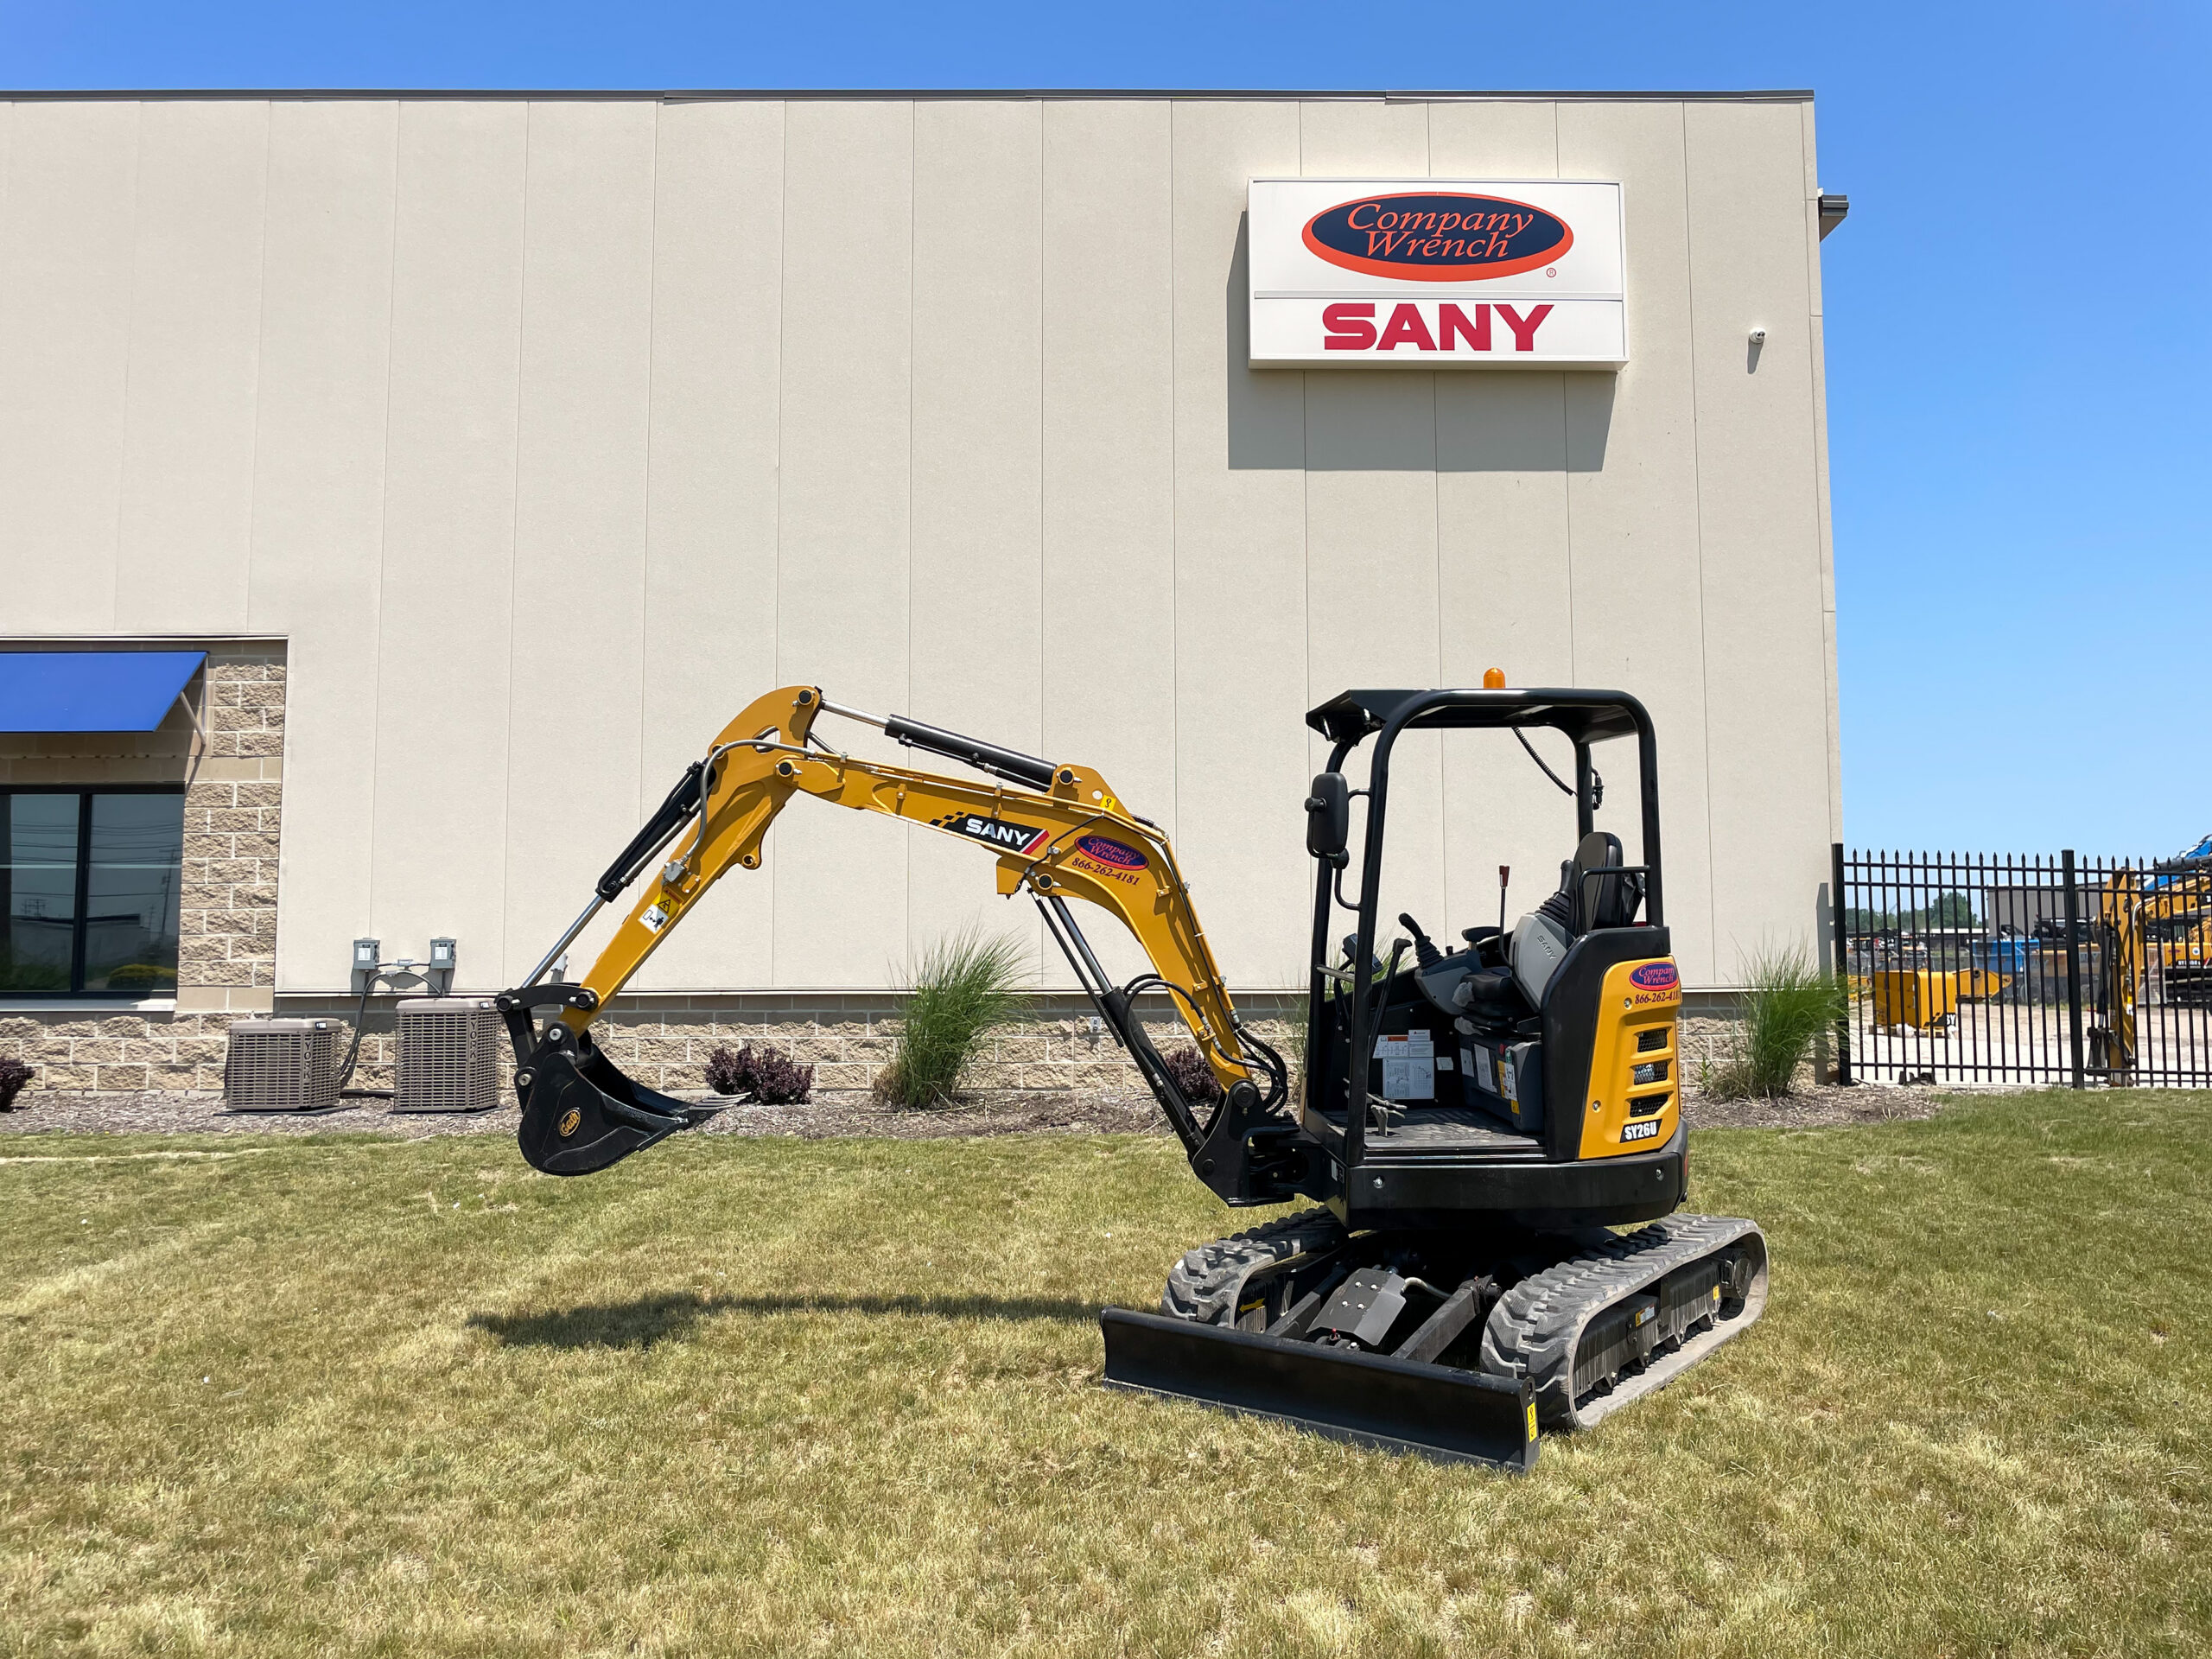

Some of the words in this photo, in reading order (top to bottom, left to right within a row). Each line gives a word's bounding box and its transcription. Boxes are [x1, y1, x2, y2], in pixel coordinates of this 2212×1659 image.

[1347, 203, 1534, 239] Company
[1364, 230, 1510, 257] Wrench
[1322, 302, 1554, 352] SANY
[965, 817, 1031, 846] SANY
[1088, 837, 1141, 861] Company
[1090, 846, 1131, 865] Wrench
[1072, 857, 1141, 886] 866-262-4181
[1537, 935, 1557, 960] SANY
[1643, 973, 1674, 985] Wrench
[1624, 1121, 1657, 1141] SY26U
